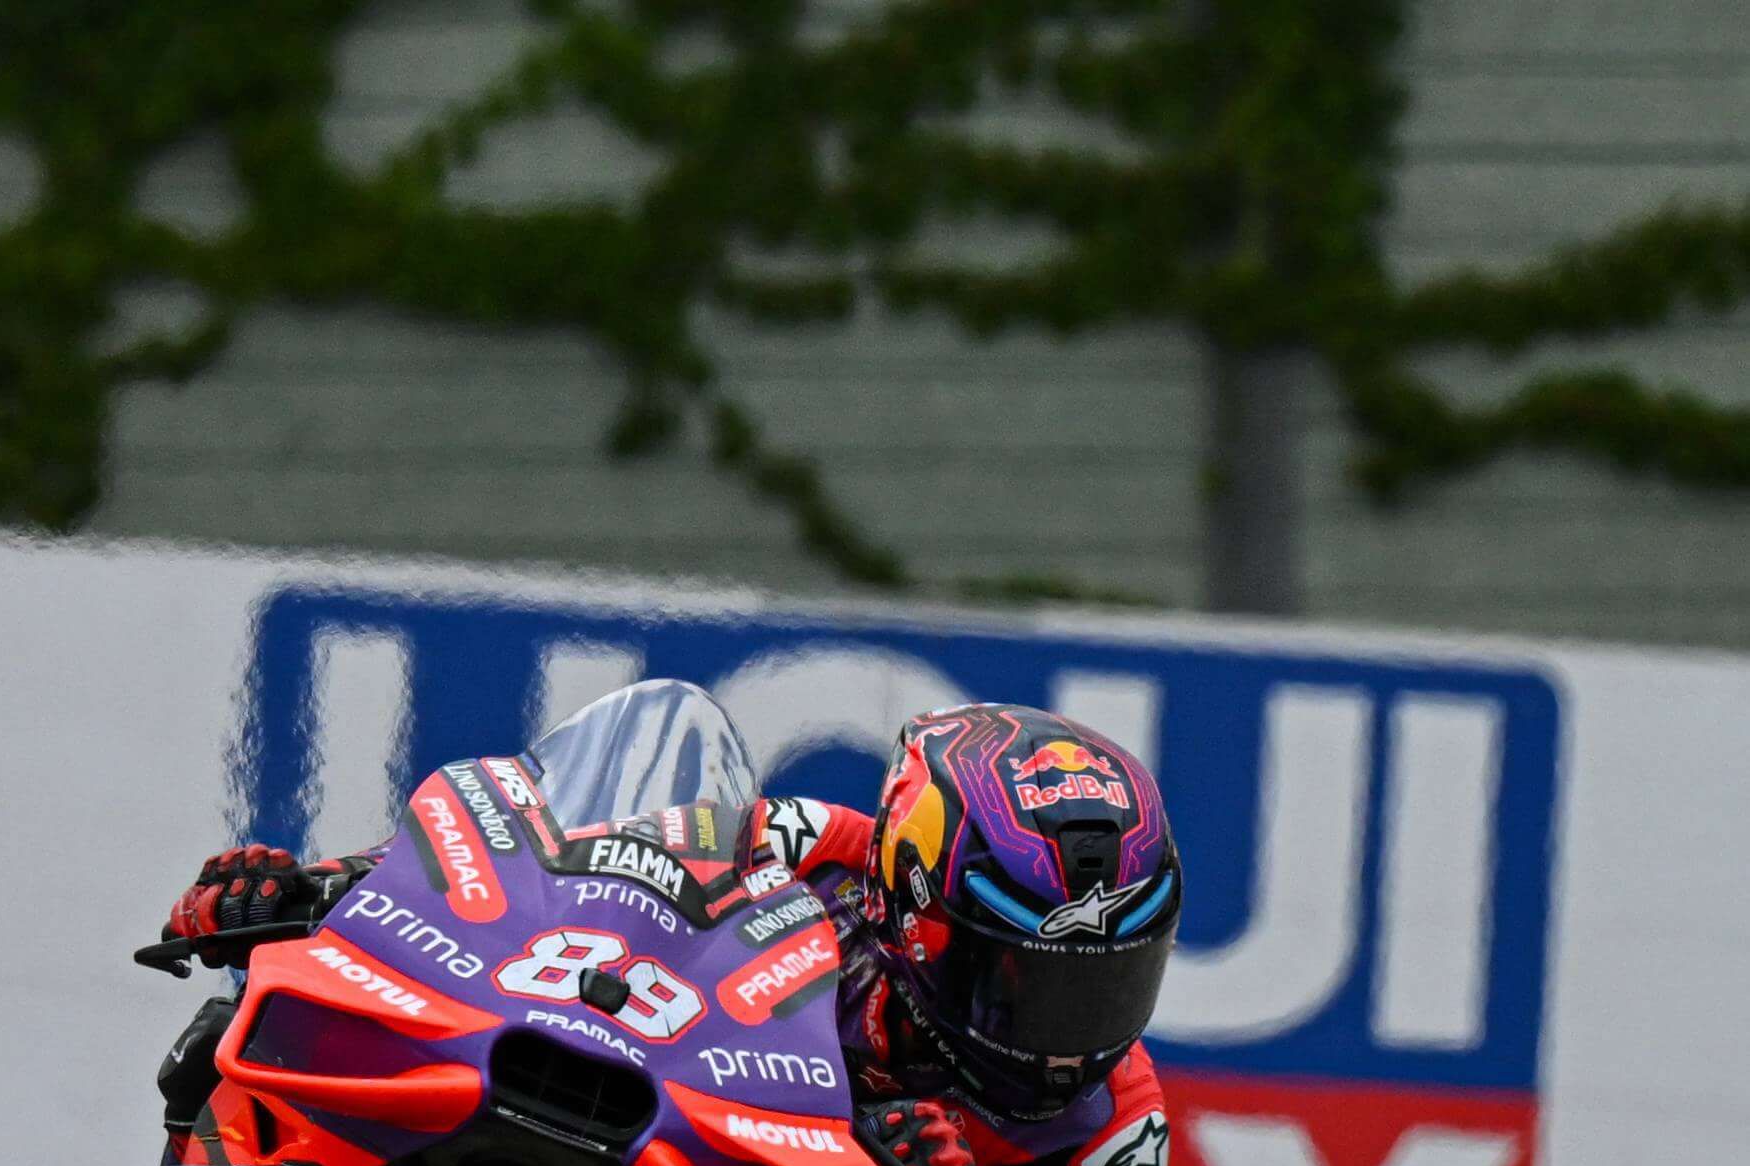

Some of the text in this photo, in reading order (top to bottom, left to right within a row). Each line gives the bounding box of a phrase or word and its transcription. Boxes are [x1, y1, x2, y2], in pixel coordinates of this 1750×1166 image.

[486, 758, 537, 807] WRS
[1015, 773, 1082, 810] Red
[312, 622, 1506, 1052] LUI
[425, 797, 490, 902] PRAMAC
[663, 807, 684, 847] OTUL
[590, 838, 686, 898] FIAMM
[744, 863, 791, 897] WRS
[346, 889, 483, 979] prima
[573, 880, 677, 934] prima
[735, 938, 834, 1007] PRAMAC
[1022, 940, 1067, 953] GIVES
[1076, 945, 1106, 955] YOU
[307, 946, 429, 1017] MOTUL
[493, 930, 705, 1043] 89
[525, 1009, 647, 1068] PRAMAC
[698, 1047, 838, 1089] prima
[726, 1113, 846, 1154] MOTUL
